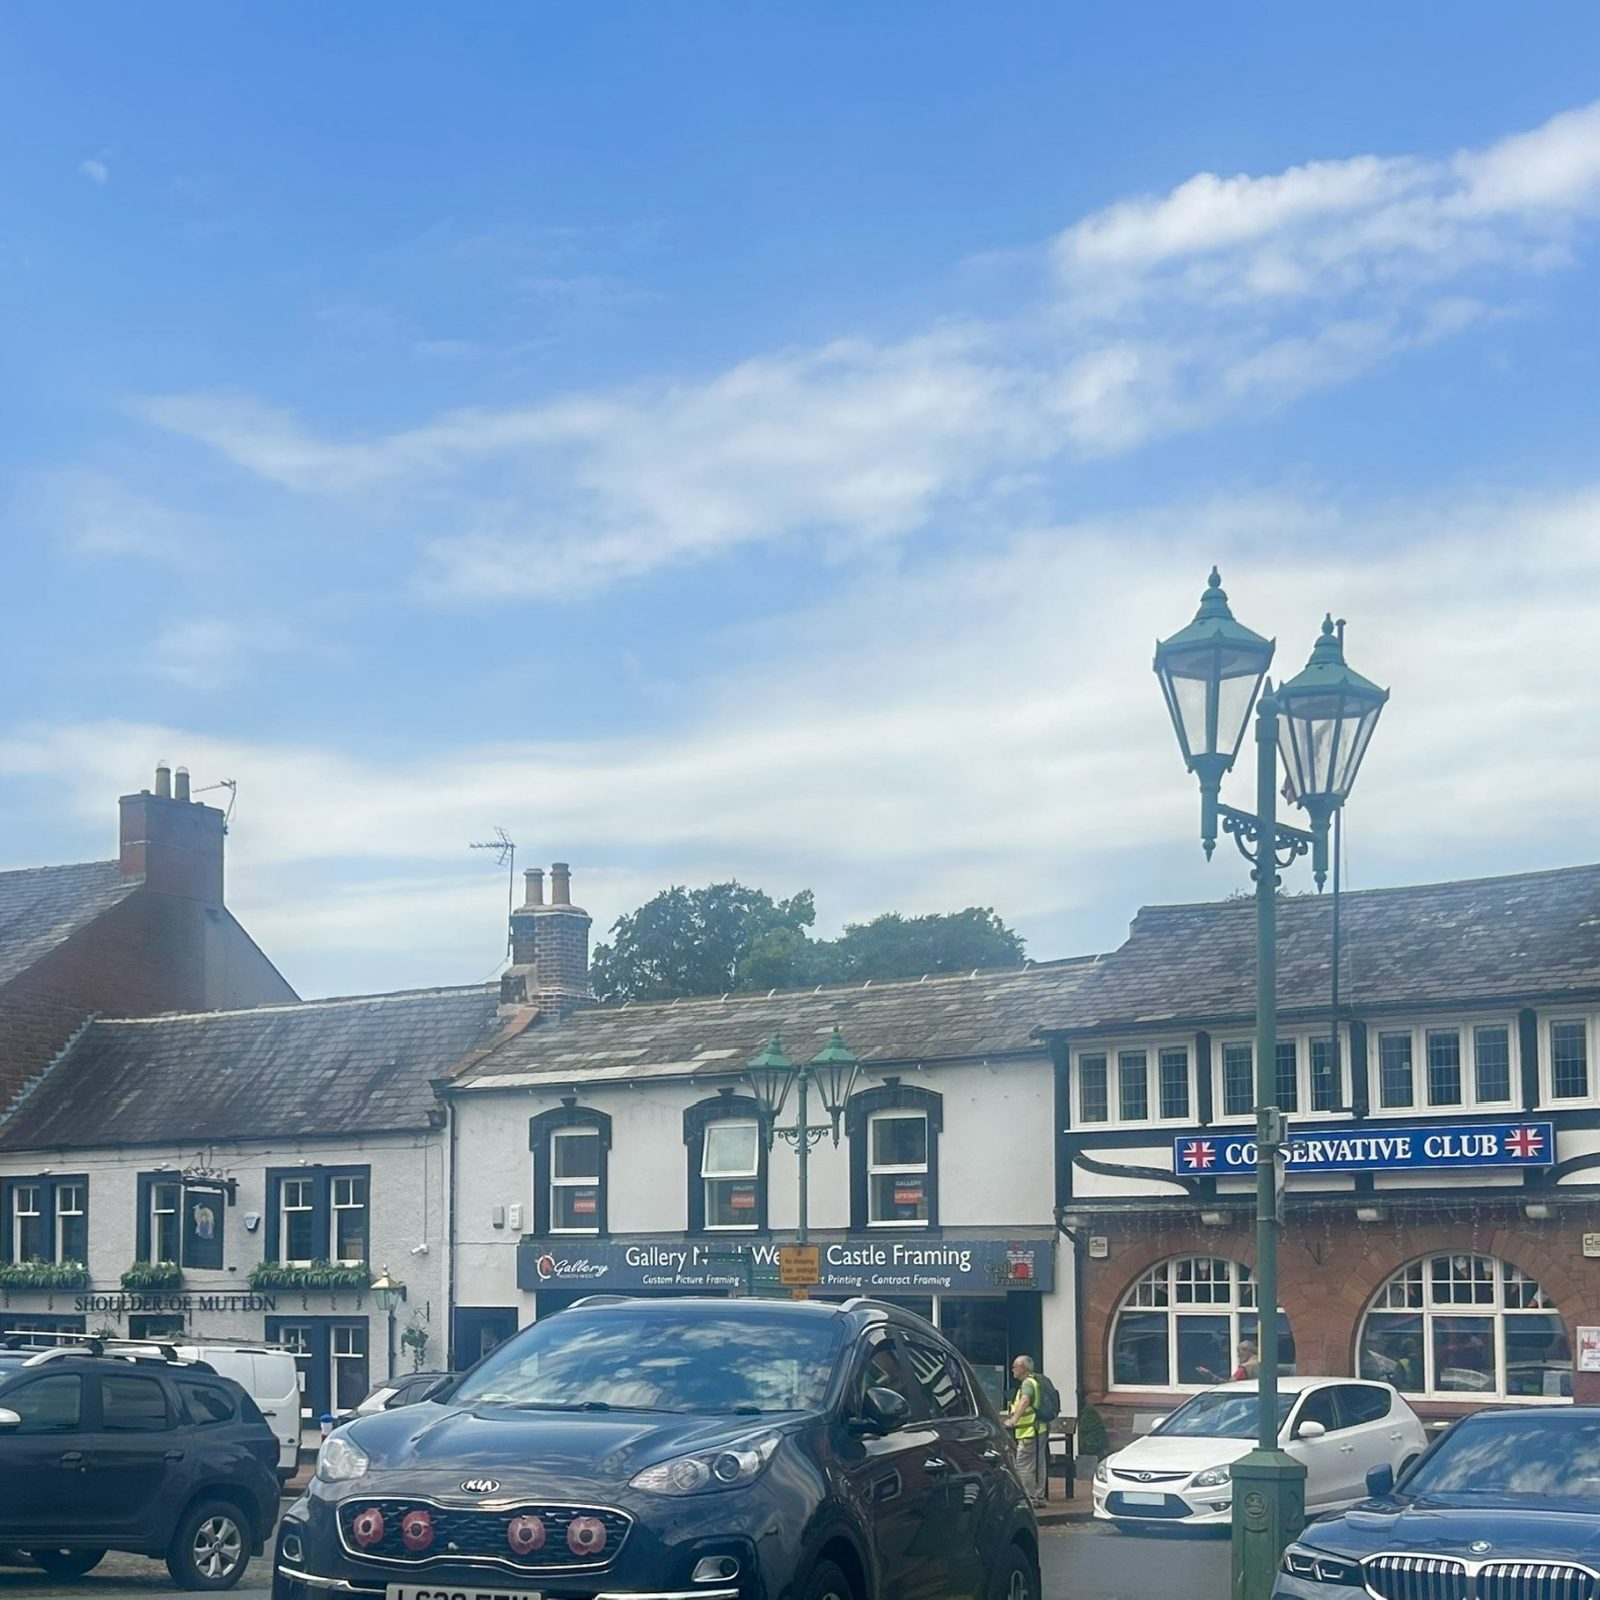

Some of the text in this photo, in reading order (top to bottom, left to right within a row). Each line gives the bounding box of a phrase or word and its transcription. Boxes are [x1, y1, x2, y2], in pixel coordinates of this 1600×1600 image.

[1225, 1134, 1499, 1166] COSERVATIVE CLUB
[625, 1246, 687, 1273] Gallery
[826, 1245, 886, 1265] Castle
[893, 1244, 972, 1272] Framing
[554, 1259, 609, 1277] Gallery
[642, 1274, 673, 1285] Custom
[675, 1274, 704, 1285] Picture
[706, 1273, 741, 1287] Framing
[827, 1274, 862, 1287] Printing
[871, 1274, 911, 1285] Contract
[913, 1274, 951, 1287] Framing
[74, 1295, 277, 1312] SHOULDER OF MUTTON
